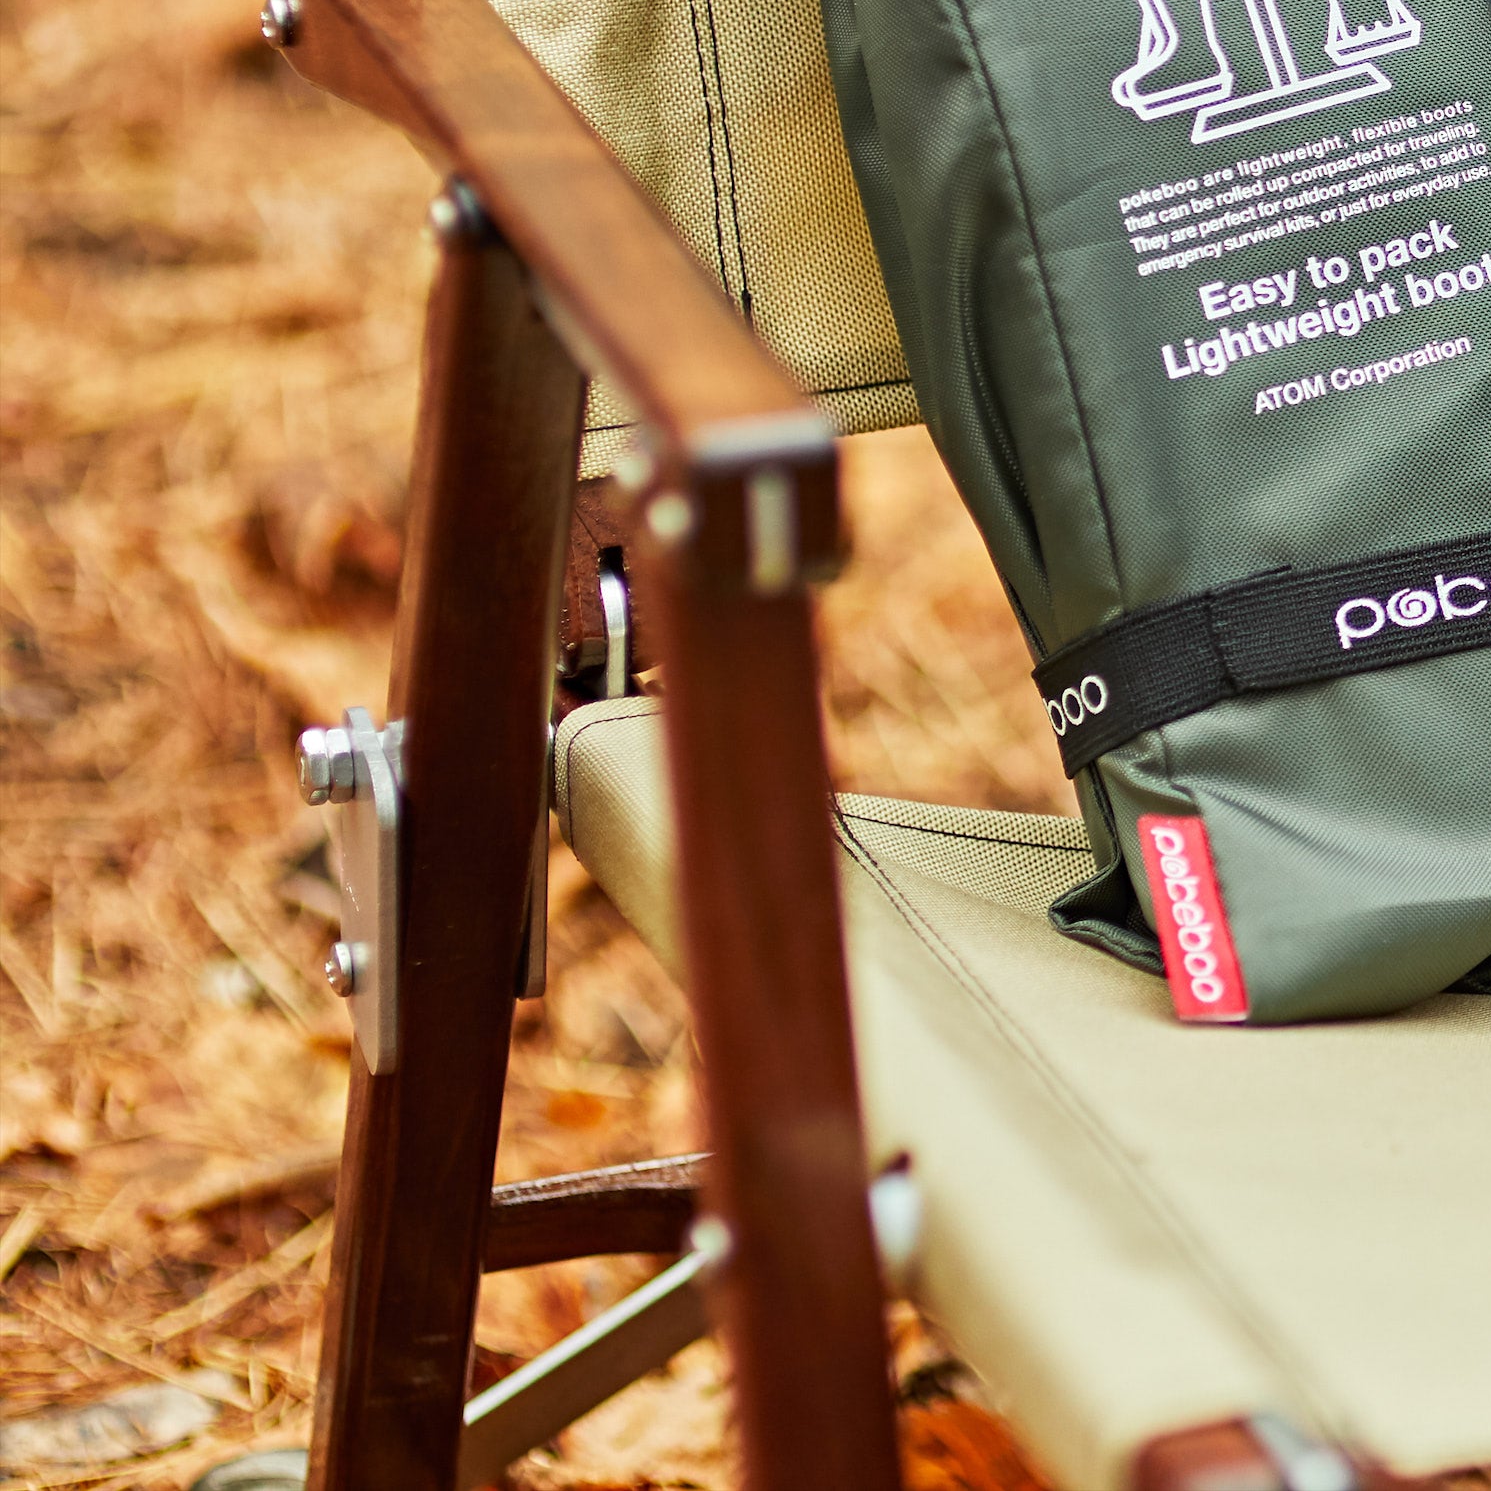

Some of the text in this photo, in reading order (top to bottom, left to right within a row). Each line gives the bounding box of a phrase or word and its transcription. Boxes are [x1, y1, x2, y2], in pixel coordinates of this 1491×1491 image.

[1118, 99, 1474, 214] pokeboo are lightweight, flexible boots
[1124, 122, 1481, 233] that can be rolled up compacted for traveling.
[1129, 141, 1487, 254] They are perfect for outdoor activities, to add to
[1137, 240, 1223, 277] emergency
[1223, 220, 1286, 251] survival
[1284, 210, 1320, 233] kits,
[1320, 209, 1338, 224] or
[1337, 196, 1368, 222] just
[1367, 190, 1392, 209] for
[1391, 173, 1461, 198] everyday
[1198, 218, 1460, 321] Easy to pack
[1160, 281, 1401, 380] Lightweight
[1254, 335, 1472, 415] ATOM Corporation
[1150, 826, 1224, 1003] pokeboo
